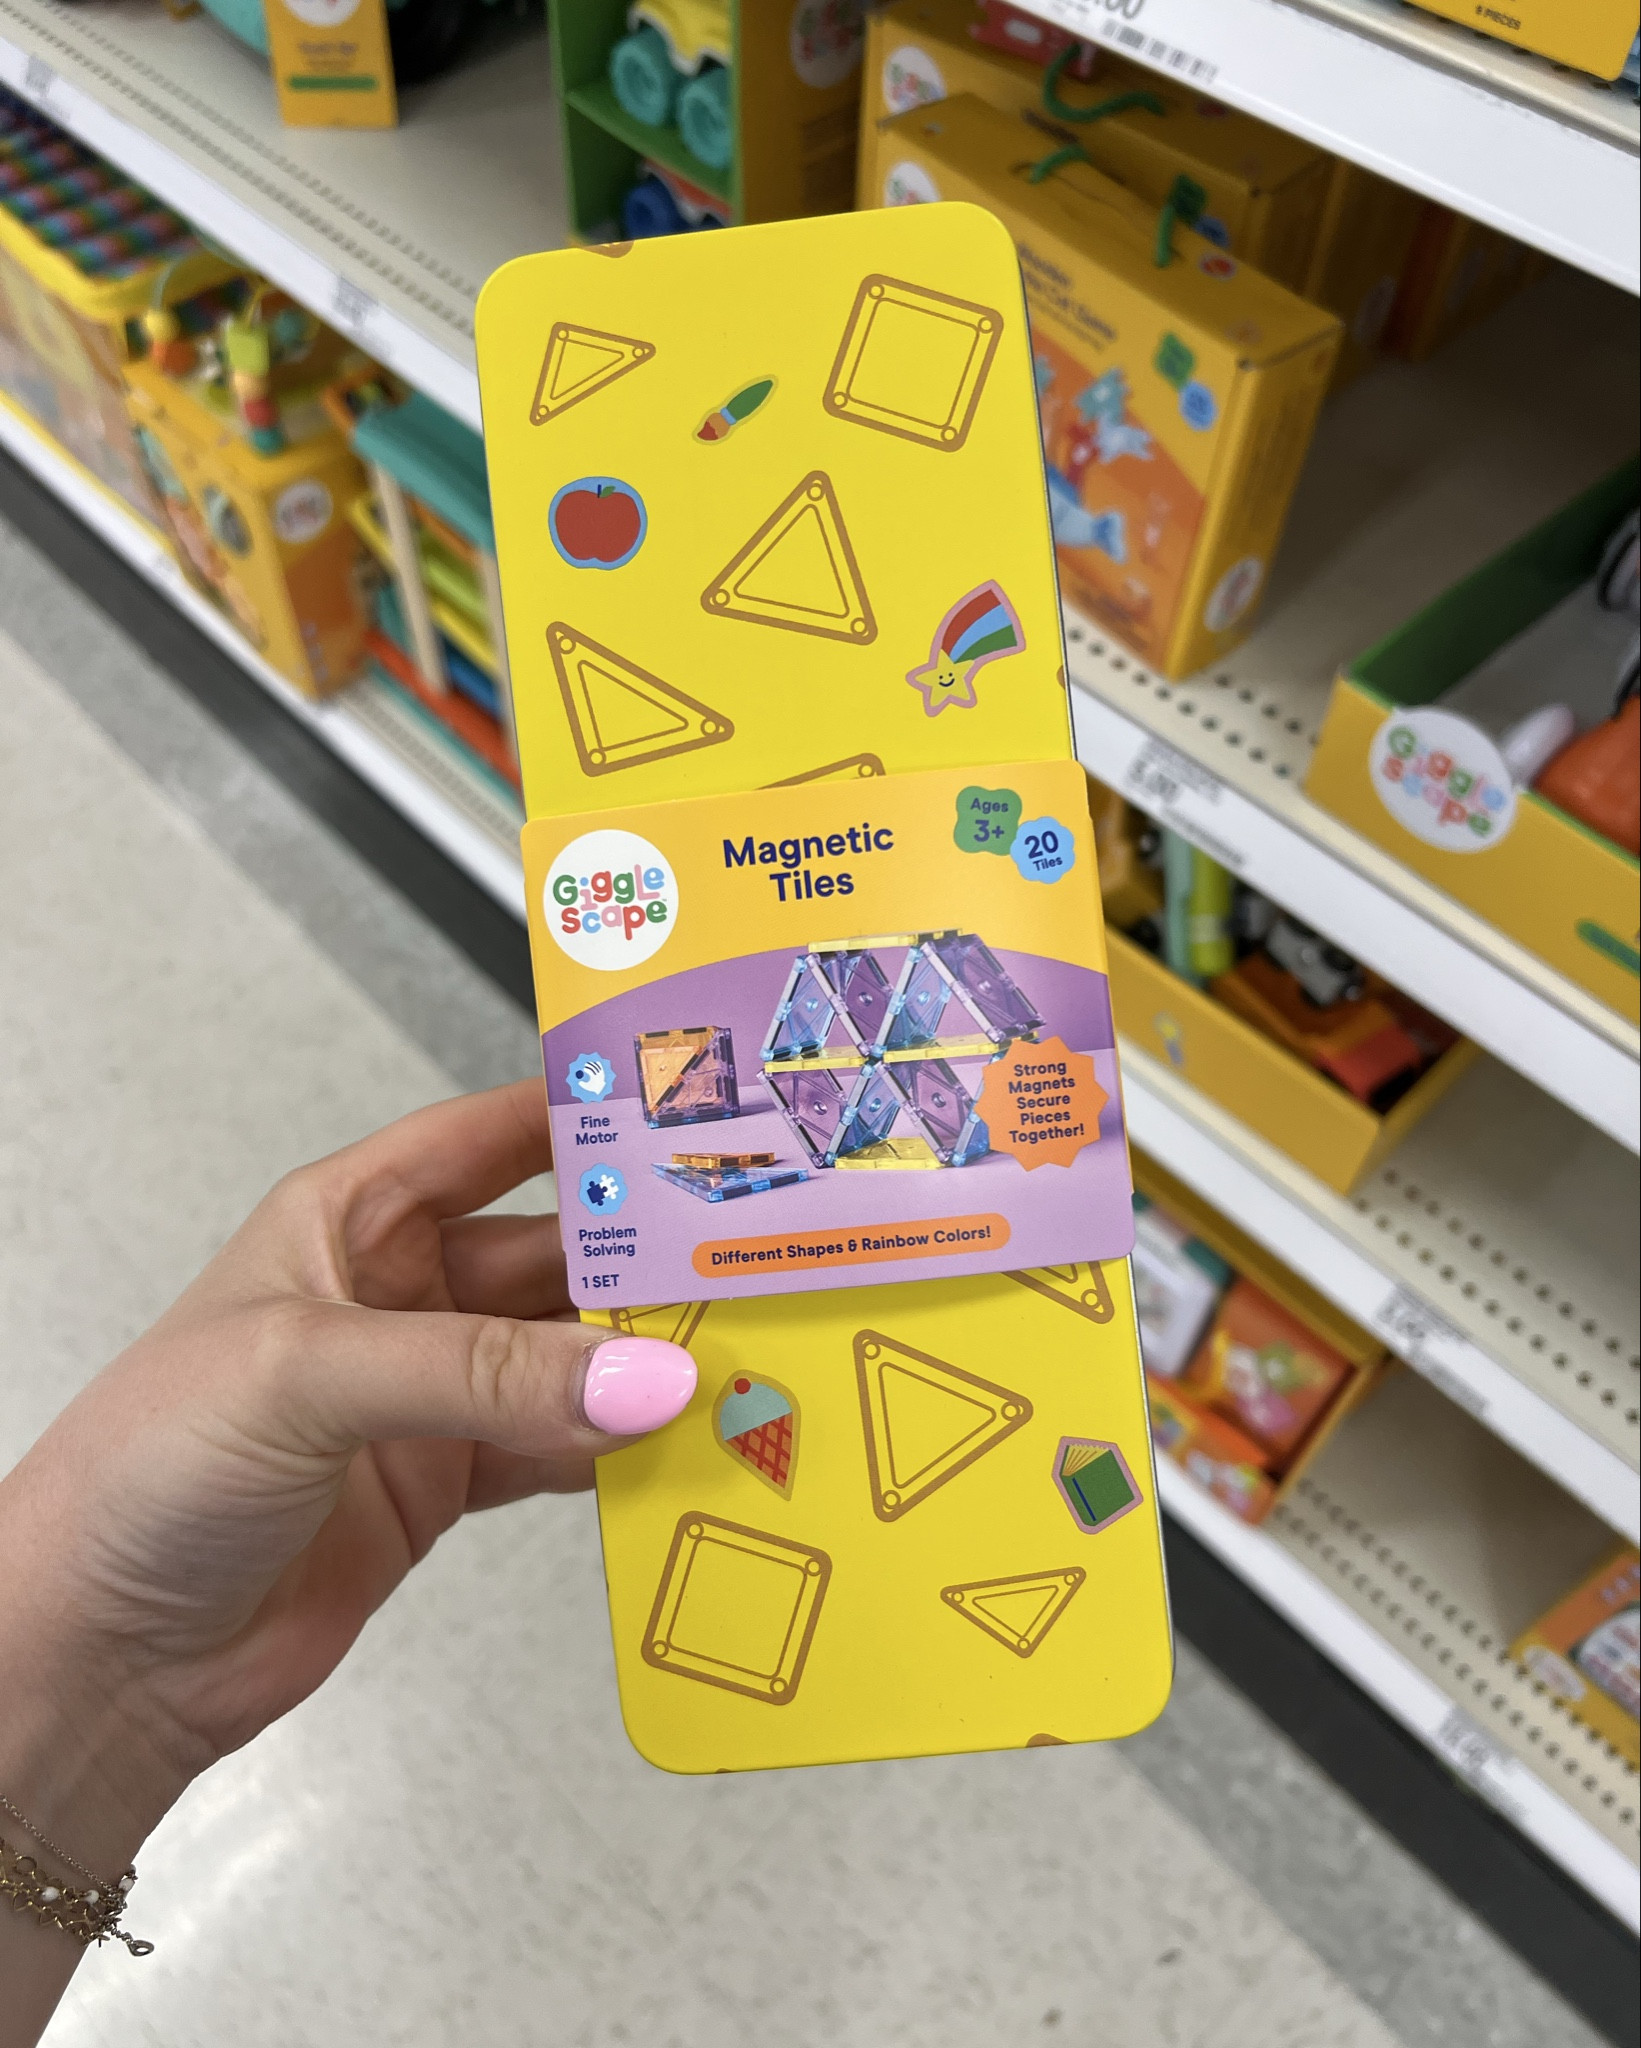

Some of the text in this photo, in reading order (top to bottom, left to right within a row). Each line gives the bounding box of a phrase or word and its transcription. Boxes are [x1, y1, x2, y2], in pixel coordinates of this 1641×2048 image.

[969, 797, 1009, 815] Ages
[973, 819, 1005, 842] 3+
[723, 822, 895, 869] Magnetic
[1024, 830, 1059, 859] 20
[1032, 857, 1063, 871] Tiles
[769, 870, 854, 902] Tiles
[1014, 1062, 1066, 1077] Strong
[1008, 1077, 1075, 1094] Magnets
[1016, 1095, 1071, 1109] Secure
[580, 1115, 611, 1129] Fine
[1020, 1111, 1071, 1125] Pieces
[575, 1131, 619, 1146] Motor
[1009, 1123, 1084, 1144] Together!
[578, 1226, 637, 1242] Problem
[583, 1243, 636, 1258] Solving
[711, 1225, 991, 1266] Different Shapes & Rainbow Colors!
[582, 1274, 620, 1289] 1 SET
